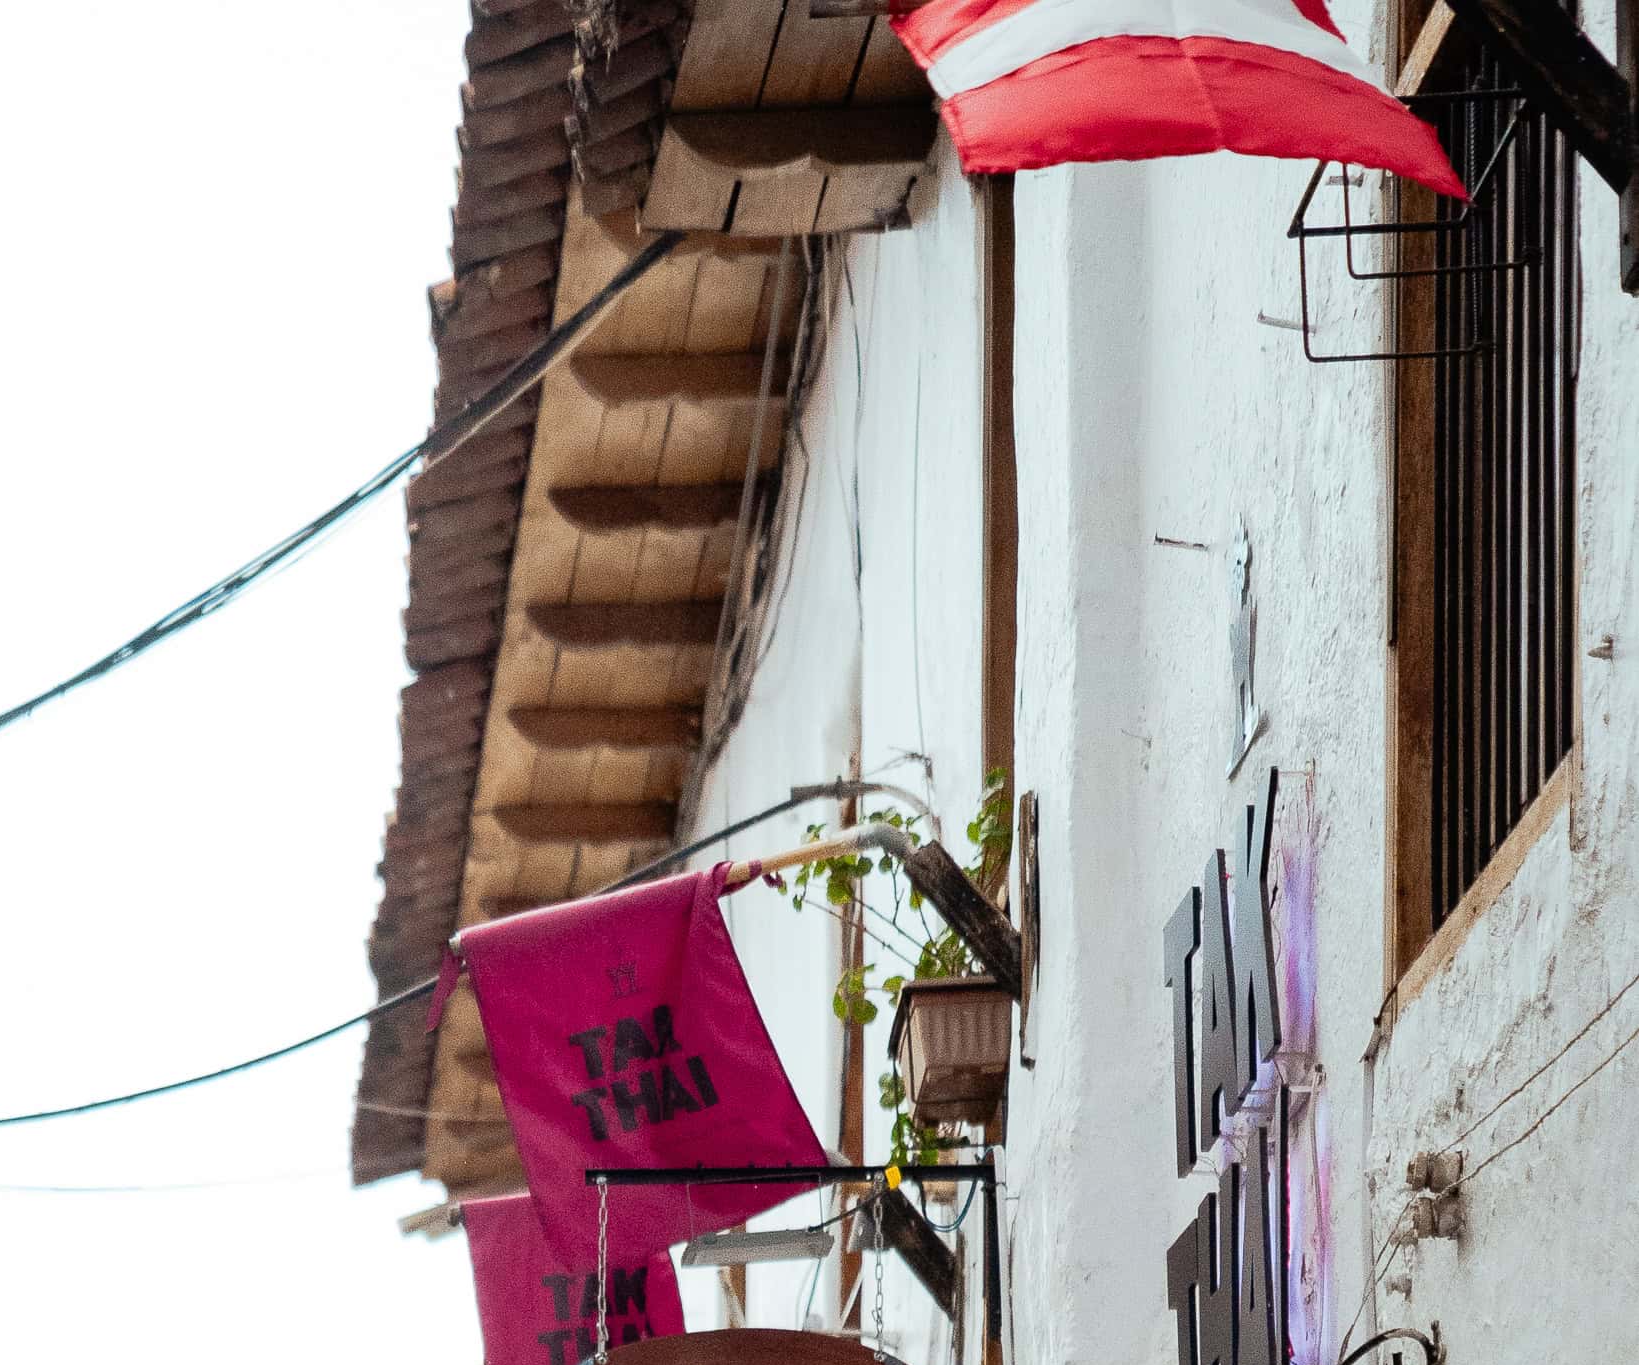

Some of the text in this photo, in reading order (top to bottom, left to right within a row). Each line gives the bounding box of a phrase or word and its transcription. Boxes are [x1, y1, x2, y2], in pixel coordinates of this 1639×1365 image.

[1163, 765, 1283, 1178] TAK
[572, 1055, 719, 1142] THAI
[542, 1268, 648, 1321] TAK
